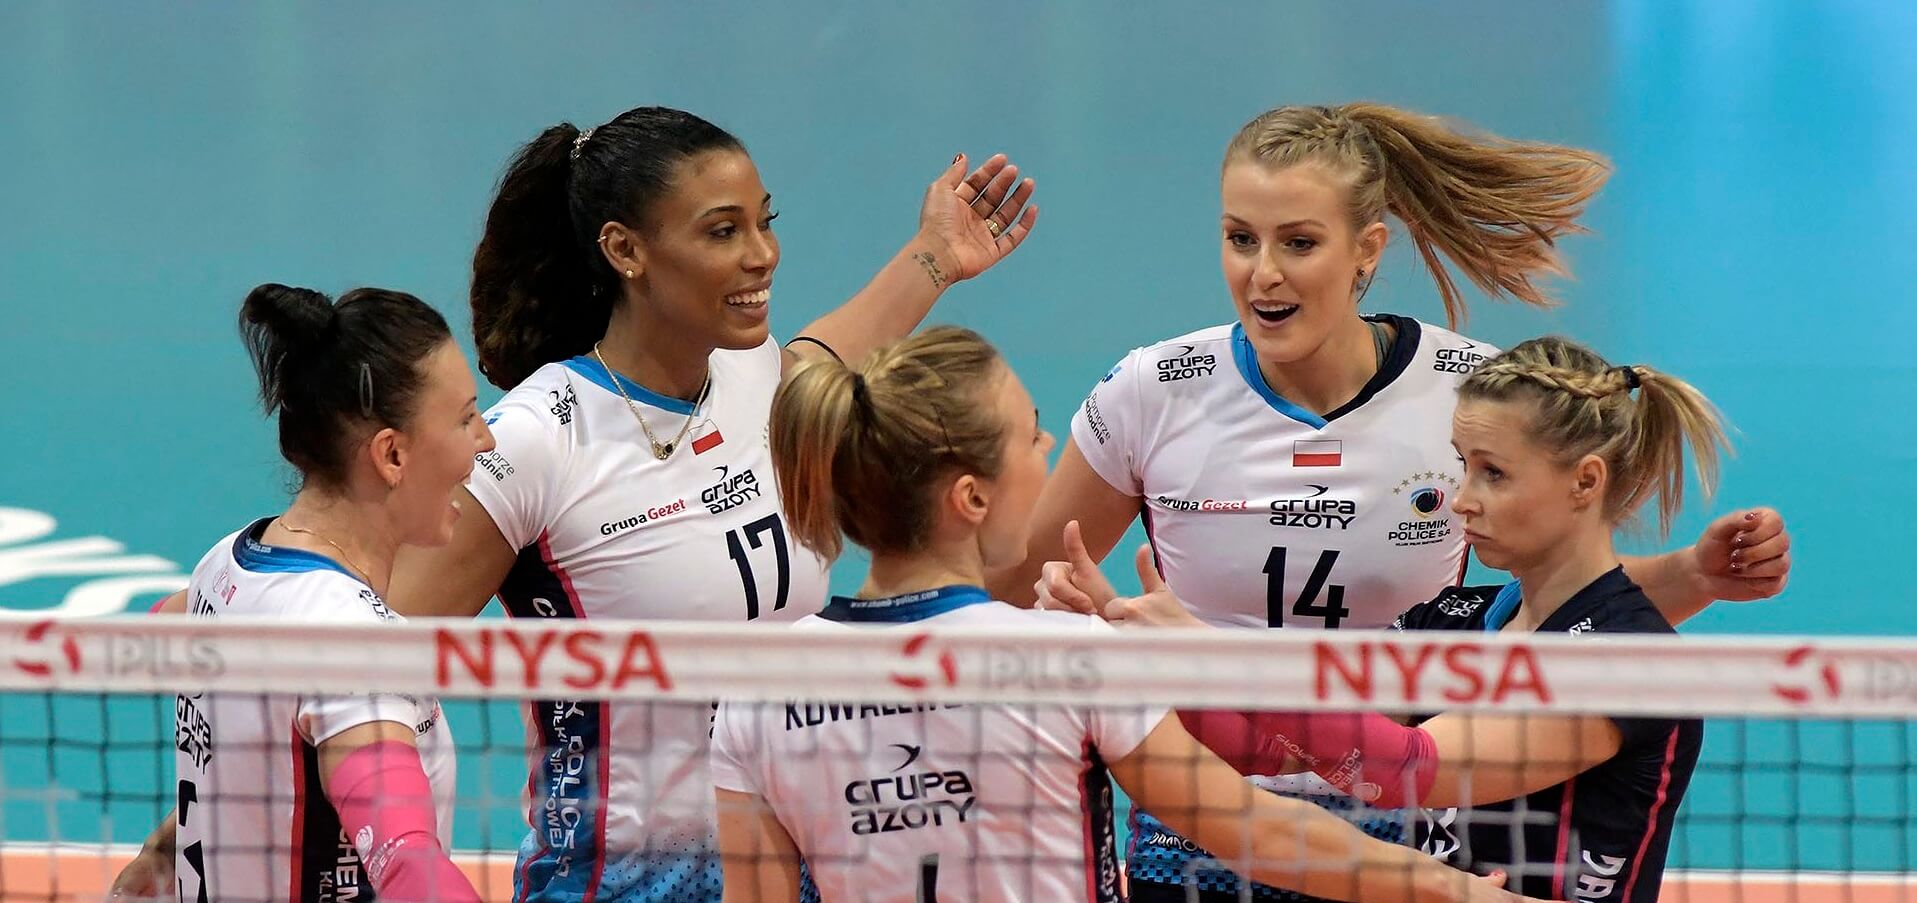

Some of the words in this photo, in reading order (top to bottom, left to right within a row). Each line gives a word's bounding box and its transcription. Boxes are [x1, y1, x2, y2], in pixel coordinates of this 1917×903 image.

[1388, 530, 1437, 541] POLICE
[1398, 519, 1449, 531] CHEMIK
[725, 512, 790, 621] 17
[1262, 546, 1350, 629] 14
[434, 627, 675, 692] NYSA
[1312, 640, 1556, 705] NYSA
